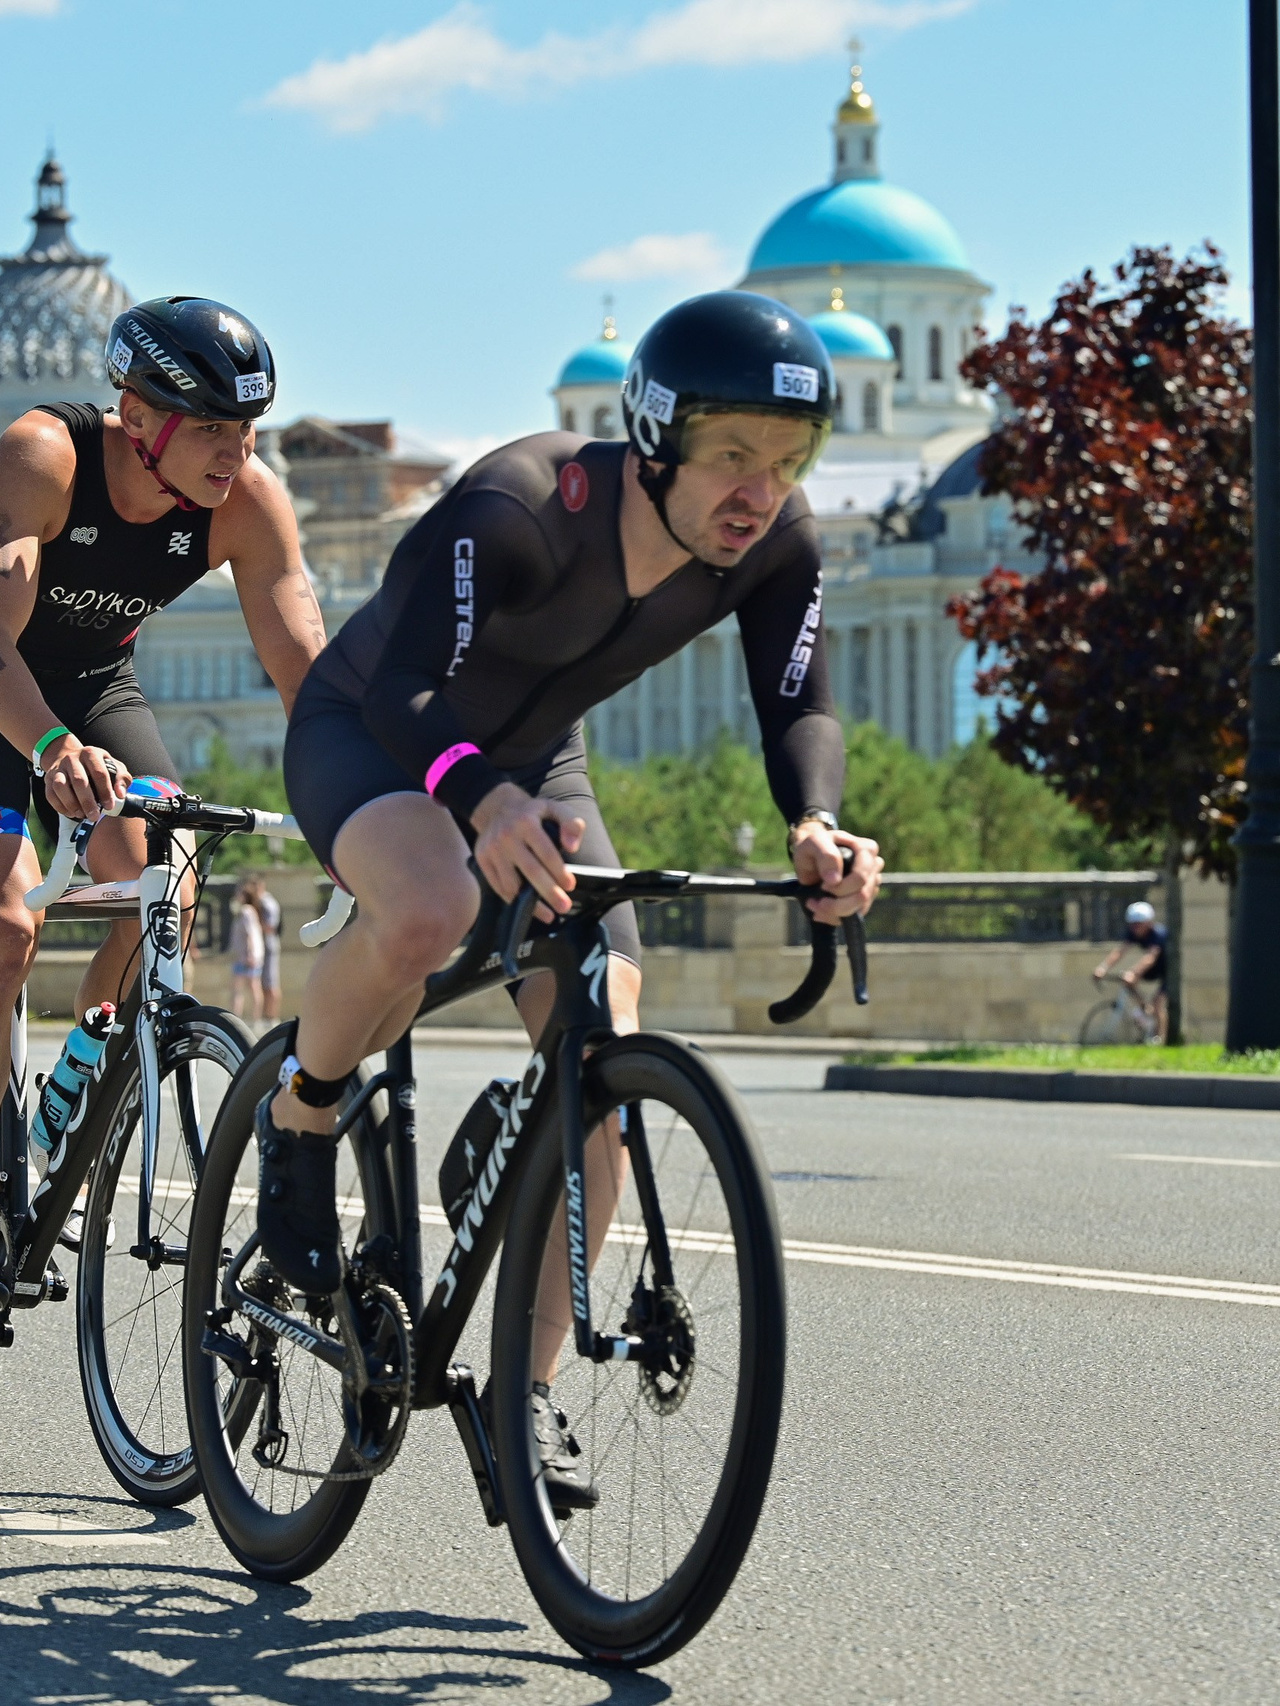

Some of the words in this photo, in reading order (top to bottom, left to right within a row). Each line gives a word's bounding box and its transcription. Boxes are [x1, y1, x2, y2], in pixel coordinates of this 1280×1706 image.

[242, 382, 264, 398] 399
[782, 376, 812, 396] 507
[57, 608, 114, 630] RUS
[566, 1167, 589, 1321] SPECIALIZED
[241, 1300, 318, 1351] SPECIALIZED
